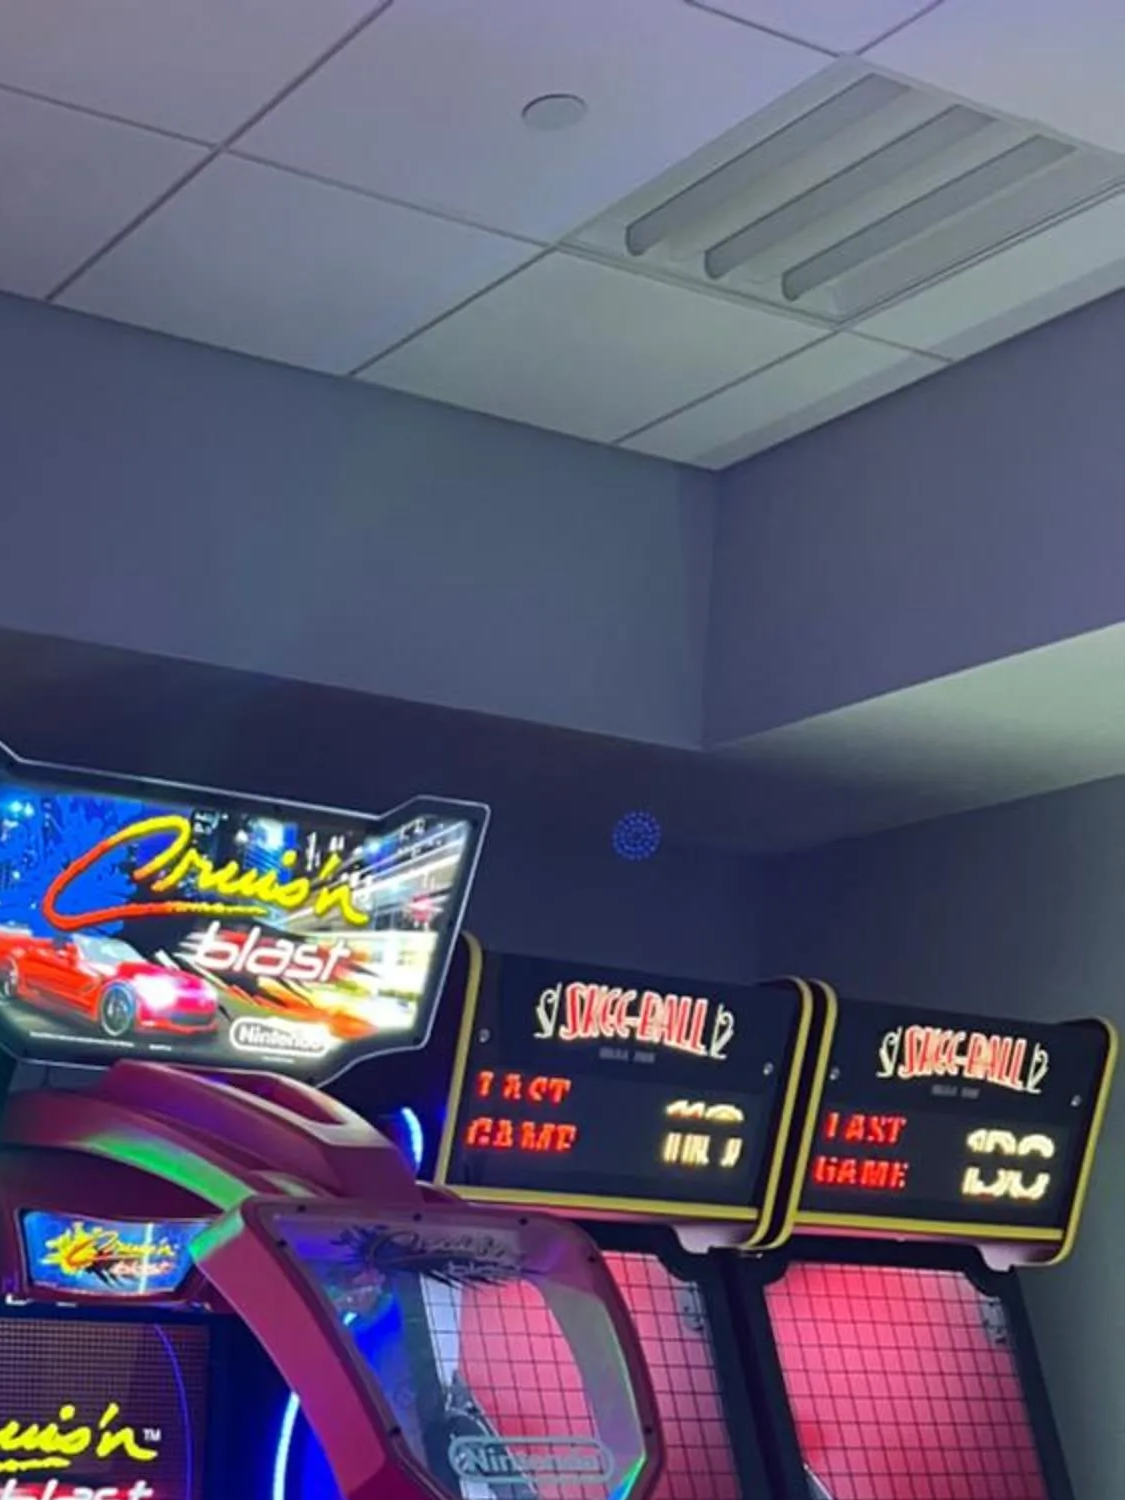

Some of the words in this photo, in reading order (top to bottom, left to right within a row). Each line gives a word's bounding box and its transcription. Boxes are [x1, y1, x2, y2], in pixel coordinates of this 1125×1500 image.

[42, 815, 370, 931] Cruis'n
[196, 921, 350, 982] blast
[812, 1155, 909, 1188] GAME
